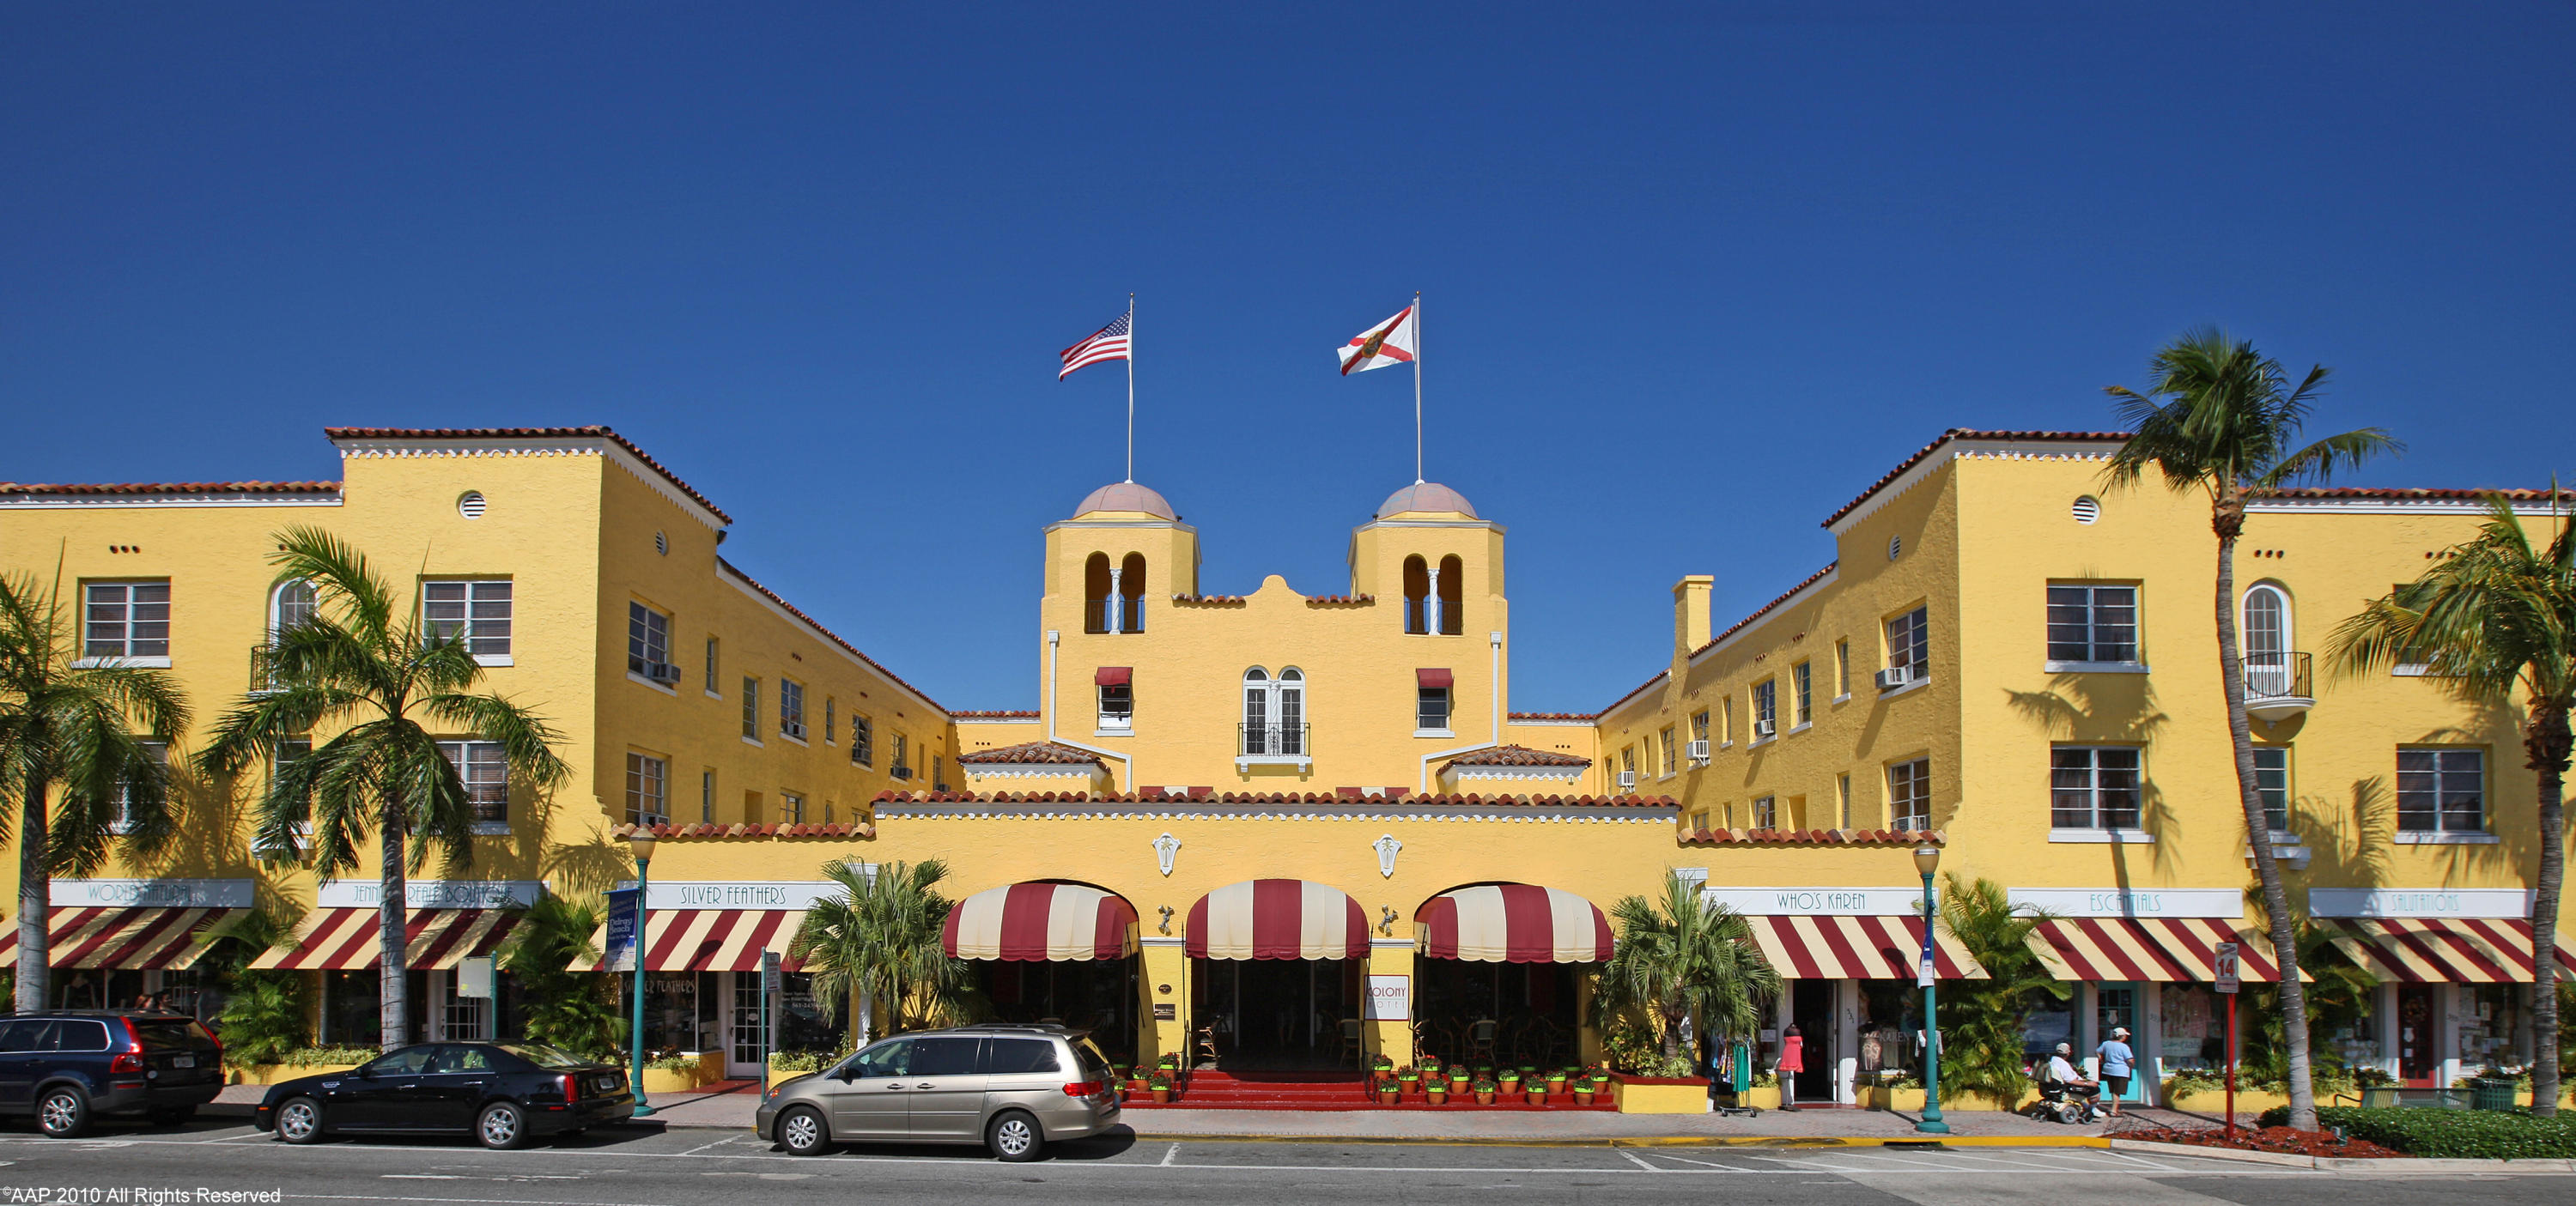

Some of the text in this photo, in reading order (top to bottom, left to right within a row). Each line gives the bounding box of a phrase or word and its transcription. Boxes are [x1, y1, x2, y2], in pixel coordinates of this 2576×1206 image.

[88, 884, 191, 901] WORLD NATURAL
[407, 885, 439, 902] REALE
[445, 886, 513, 903] BOUTIQUE
[680, 887, 787, 905] SILVER FEATHERS
[1777, 893, 1865, 910] WHO'S KAREN
[2090, 894, 2161, 912] ESCENTIALS
[2391, 894, 2459, 912] SALUTATIONS
[2218, 958, 2235, 977] 14
[624, 979, 654, 995] SILER
[1367, 987, 1406, 997] COLONY
